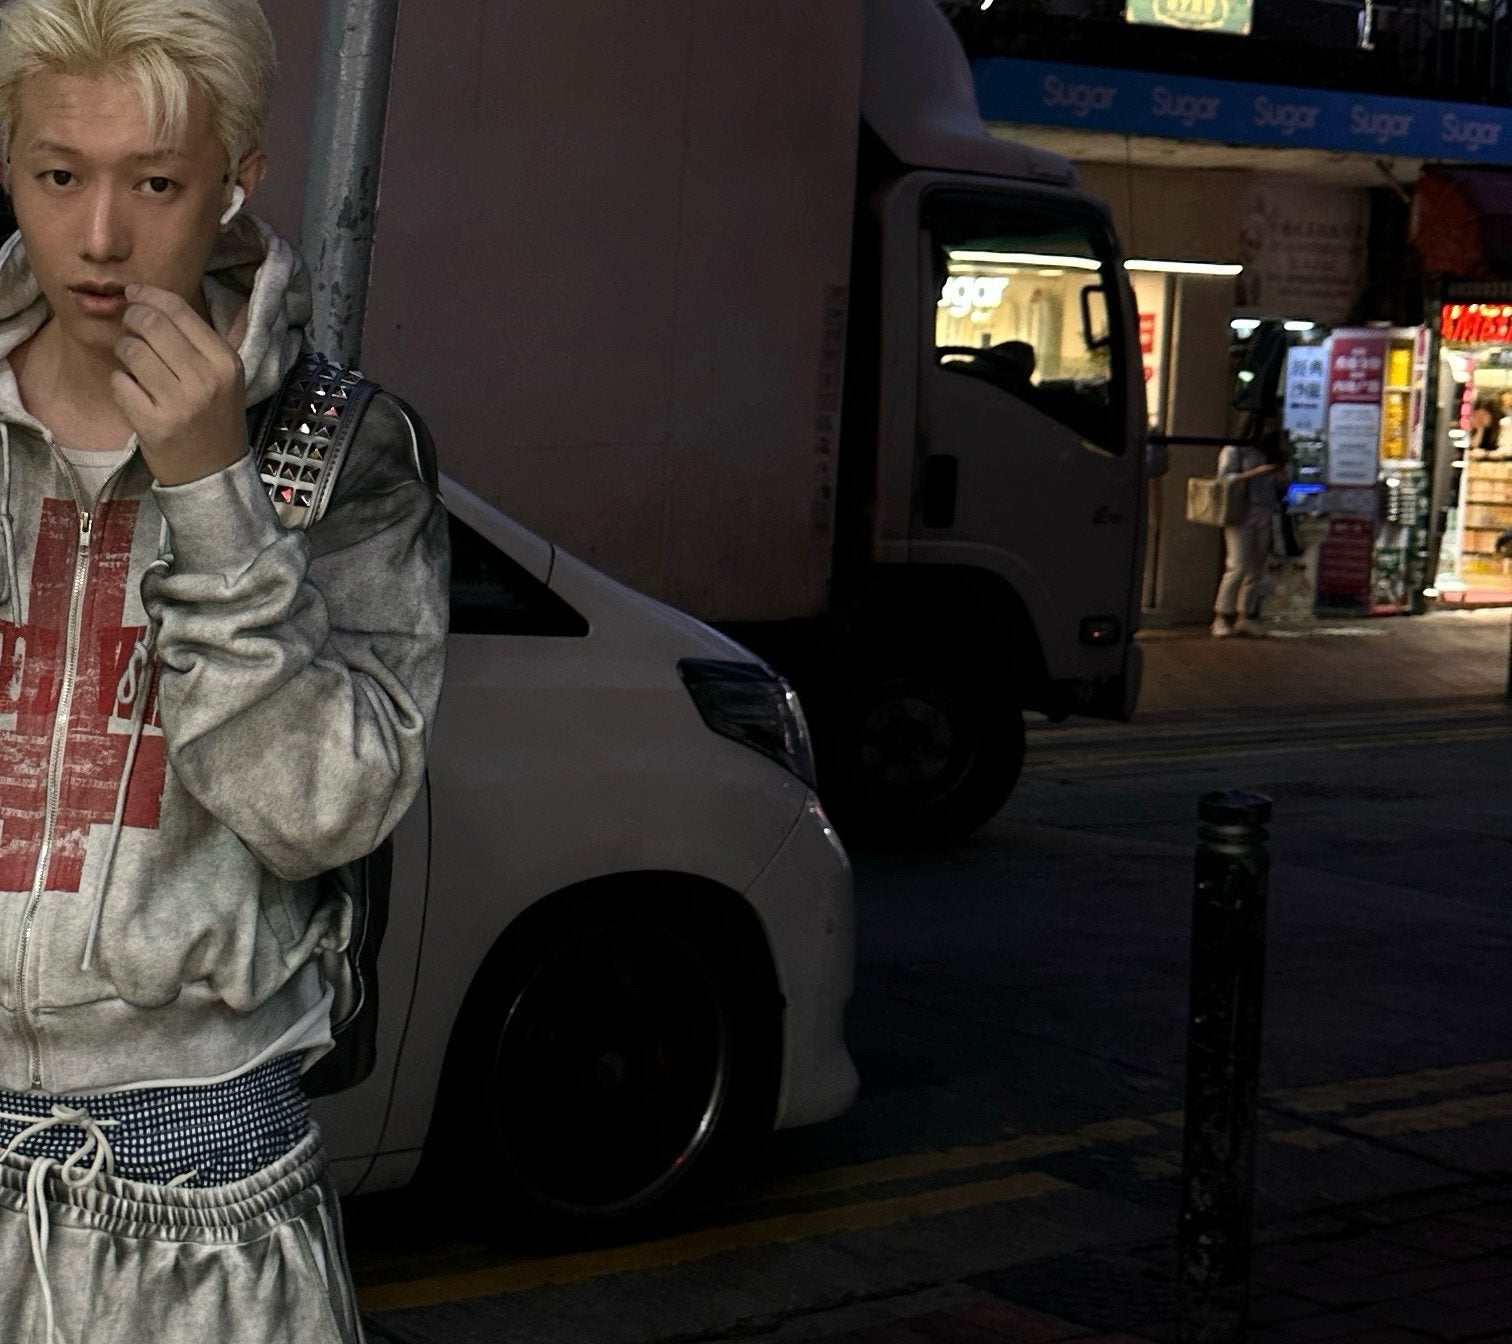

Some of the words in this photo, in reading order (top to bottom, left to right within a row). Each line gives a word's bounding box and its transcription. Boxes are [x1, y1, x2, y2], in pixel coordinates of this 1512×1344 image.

[1042, 74, 1118, 117] Sugar
[1153, 86, 1222, 127] Sugar
[1253, 95, 1321, 136] Sugar
[1349, 104, 1414, 144] Sugar
[1442, 112, 1503, 152] Sugar
